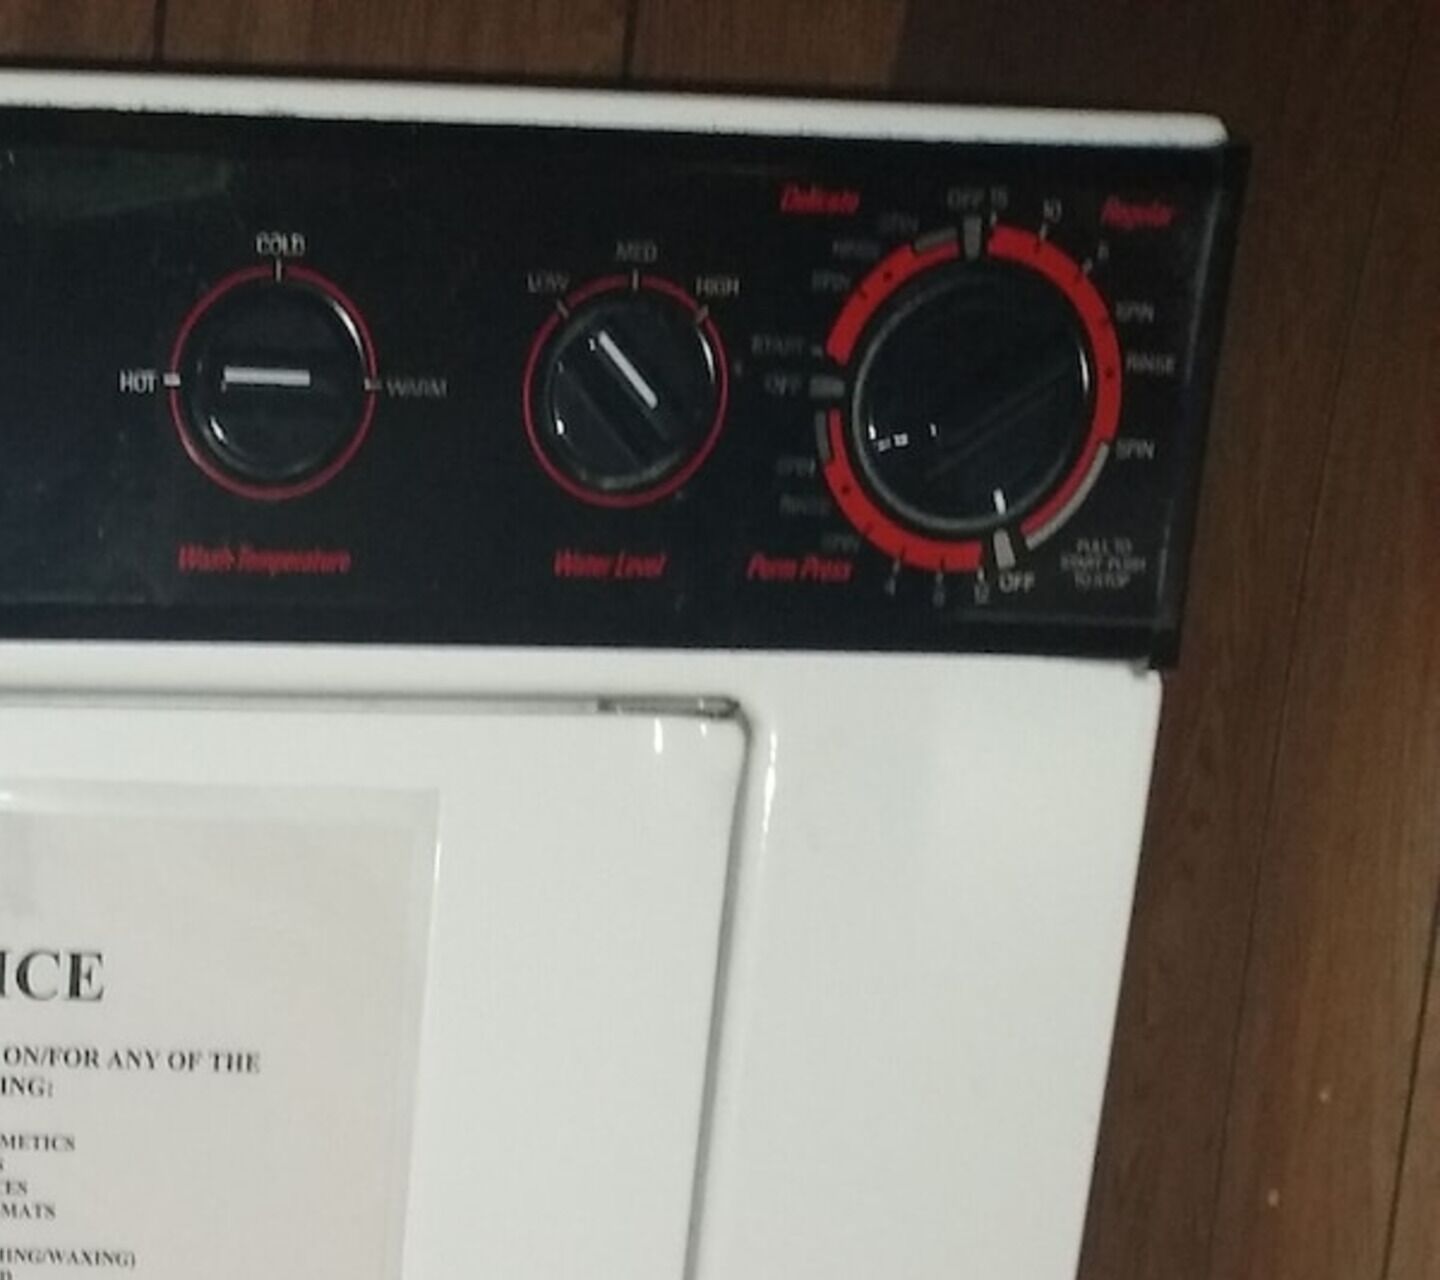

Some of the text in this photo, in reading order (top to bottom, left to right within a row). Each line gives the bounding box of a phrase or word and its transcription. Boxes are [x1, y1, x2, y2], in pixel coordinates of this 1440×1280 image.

[255, 232, 307, 256] COLD
[118, 369, 158, 393] HOT
[998, 570, 1035, 594] OFF
[3, 1046, 99, 1068] ON/FOR
[108, 1048, 159, 1070] ANY
[168, 1051, 202, 1072] OF
[210, 1052, 259, 1073] THE
[0, 1201, 56, 1219] MATS
